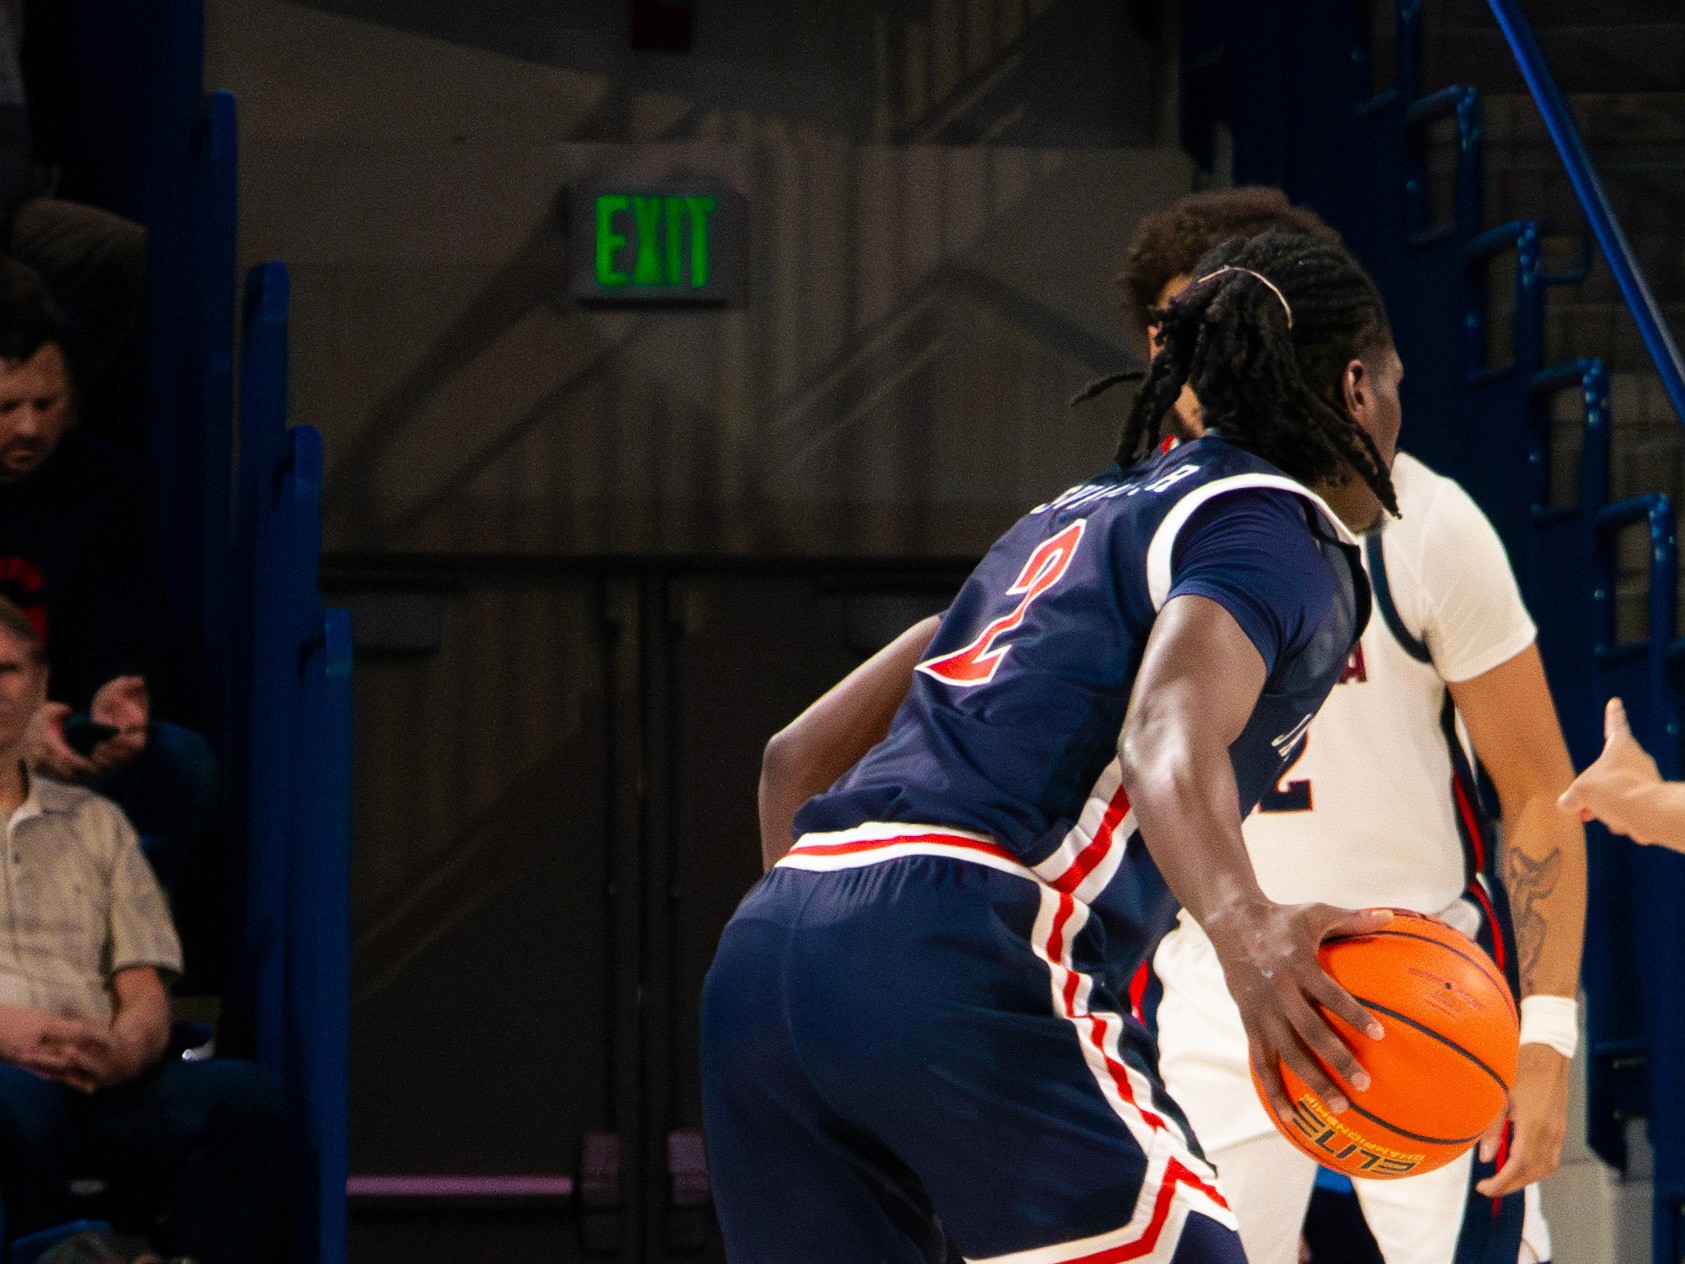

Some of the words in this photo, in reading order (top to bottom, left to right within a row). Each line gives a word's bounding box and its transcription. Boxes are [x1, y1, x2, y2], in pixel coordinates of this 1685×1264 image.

[596, 195, 715, 289] EXIT
[915, 519, 1086, 686] 2
[1291, 1102, 1417, 1176] ELITE
